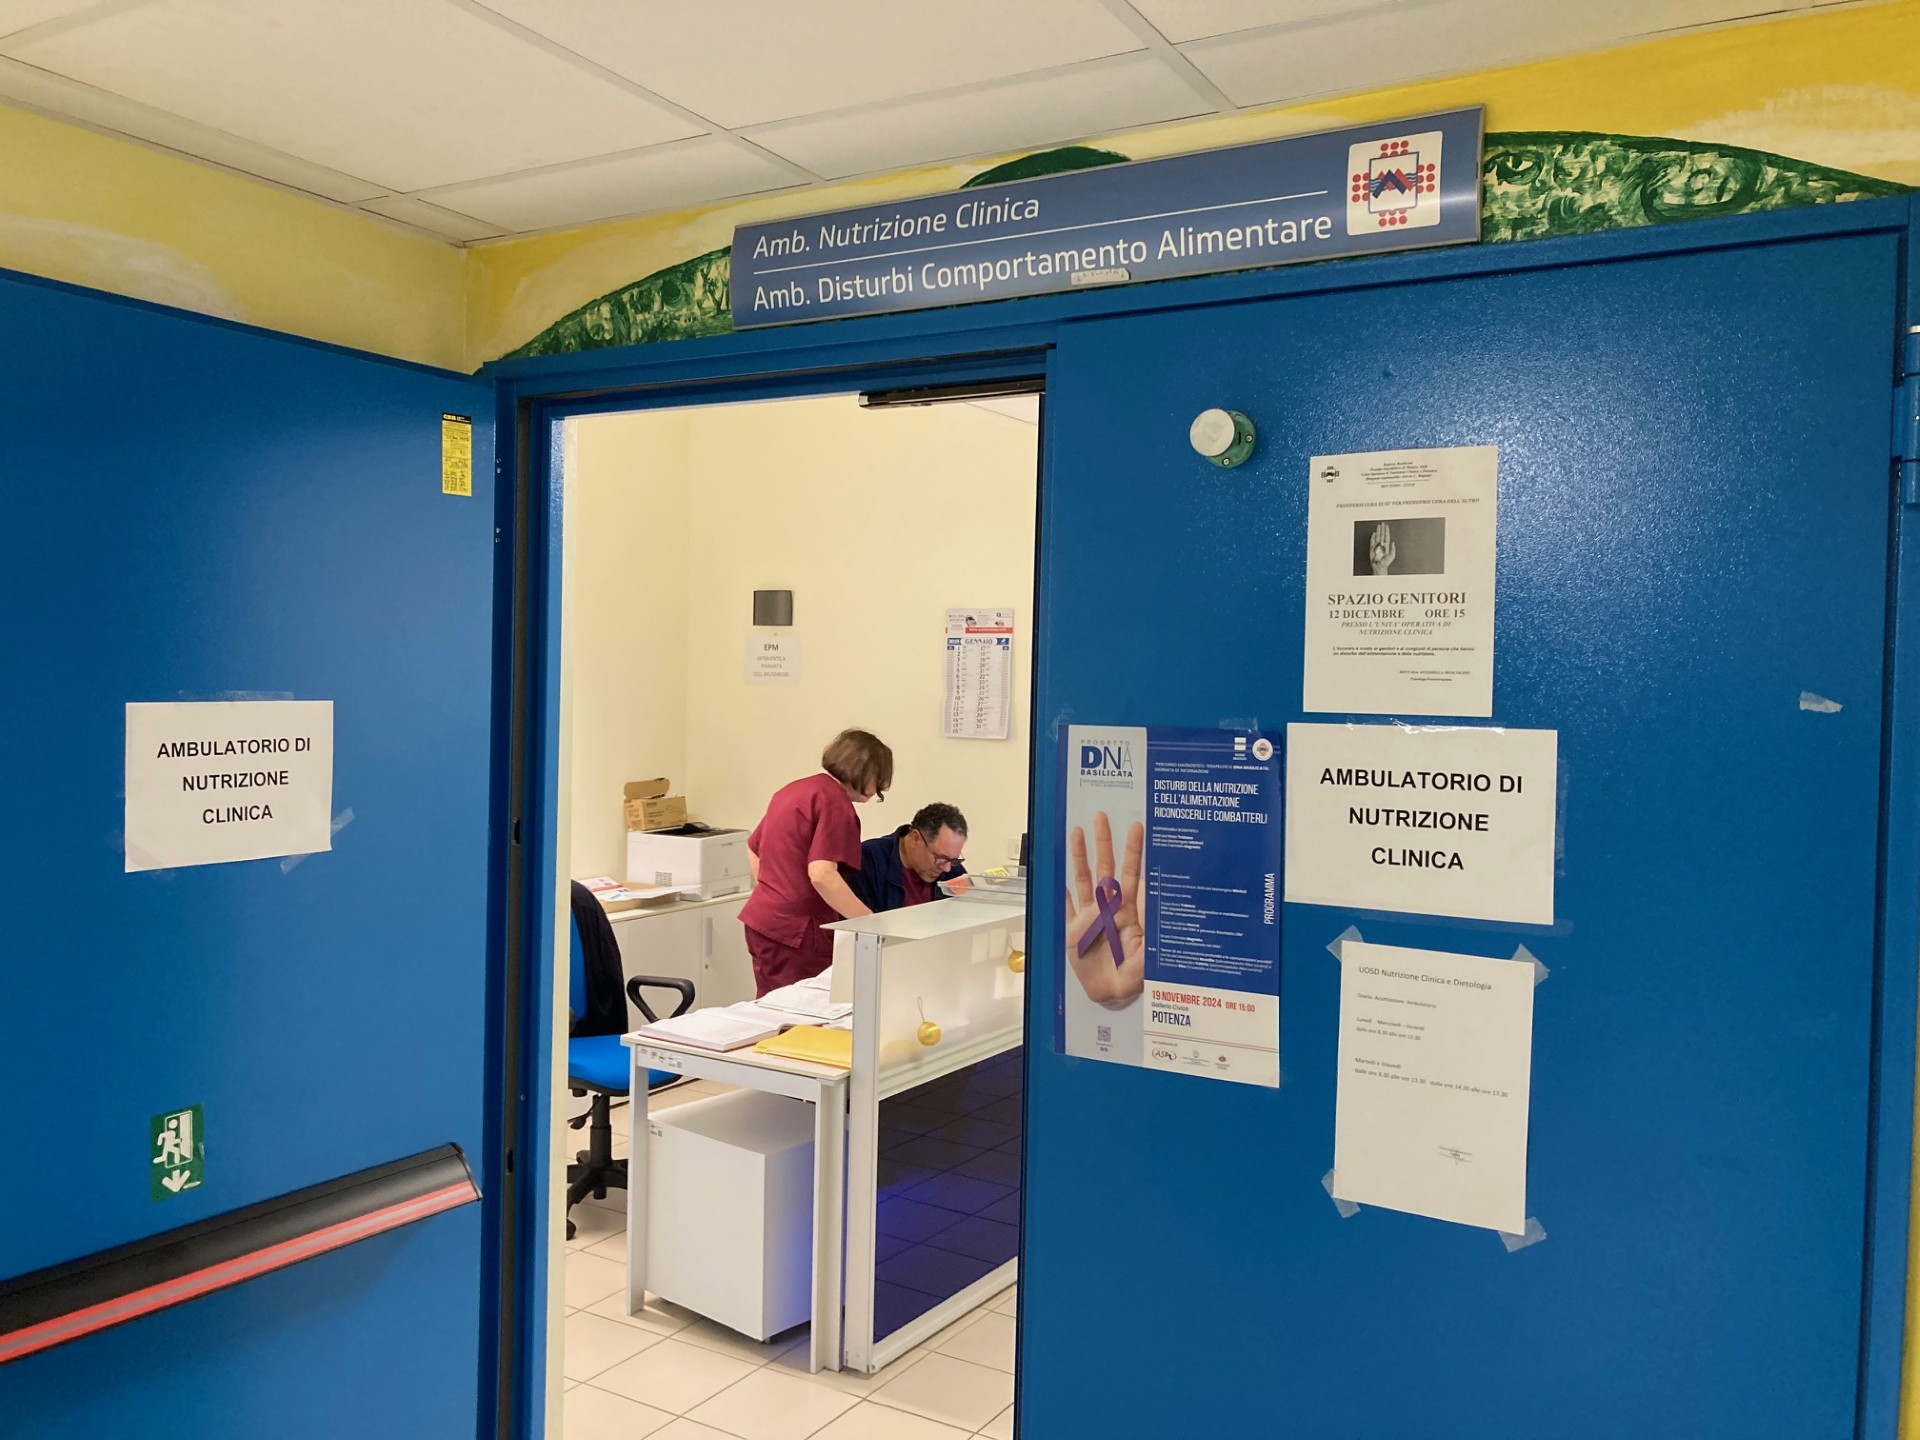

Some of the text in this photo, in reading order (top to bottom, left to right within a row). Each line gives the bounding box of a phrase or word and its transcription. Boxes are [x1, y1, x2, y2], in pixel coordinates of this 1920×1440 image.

[753, 197, 1040, 260] Amb. Nutrizione Clinica
[753, 216, 1333, 311] Amb. Disturbi Comportamento Alimentare
[1327, 592, 1466, 606] SPAZIO GENITORI
[1329, 608, 1466, 619] 12 DICEMBRE ORE 15
[1401, 620, 1442, 628] OPERATIVA
[1403, 628, 1433, 636] CLINICA
[763, 643, 779, 651] EPM
[157, 737, 311, 758] AMBULATORIO DI
[1081, 745, 1134, 770] DNA
[182, 770, 290, 793] NUTRIZIONE
[1080, 769, 1134, 778] BASILICATA
[1319, 768, 1523, 794] AMBULATORIO DI
[1154, 780, 1259, 795] DISTURBI DELLA NUTRIZIONE
[1154, 793, 1240, 808] E DELL'ALIMENTAZIONE
[202, 804, 274, 826] CLINICA
[1154, 807, 1268, 824] RICONOSCERLI E COMBATTERLI
[1348, 807, 1489, 832] NUTRIZIONE
[1370, 847, 1465, 871] CLINICA
[1264, 872, 1275, 925] PROGRAMMA
[1358, 966, 1380, 976] UOSD
[1381, 969, 1420, 981] Nutrizione
[1421, 974, 1446, 985] Clinica
[1453, 979, 1492, 991] Dietologia
[1151, 990, 1256, 1013] 19 NOVEMBRE 2024 ORE 15:00
[1152, 1001, 1189, 1012] Galleria Civica
[1152, 1010, 1192, 1027] POTENZA
[1354, 1067, 1367, 1075] dalle
[1429, 1079, 1443, 1087] dalle
[1492, 1089, 1509, 1098] 17.30
